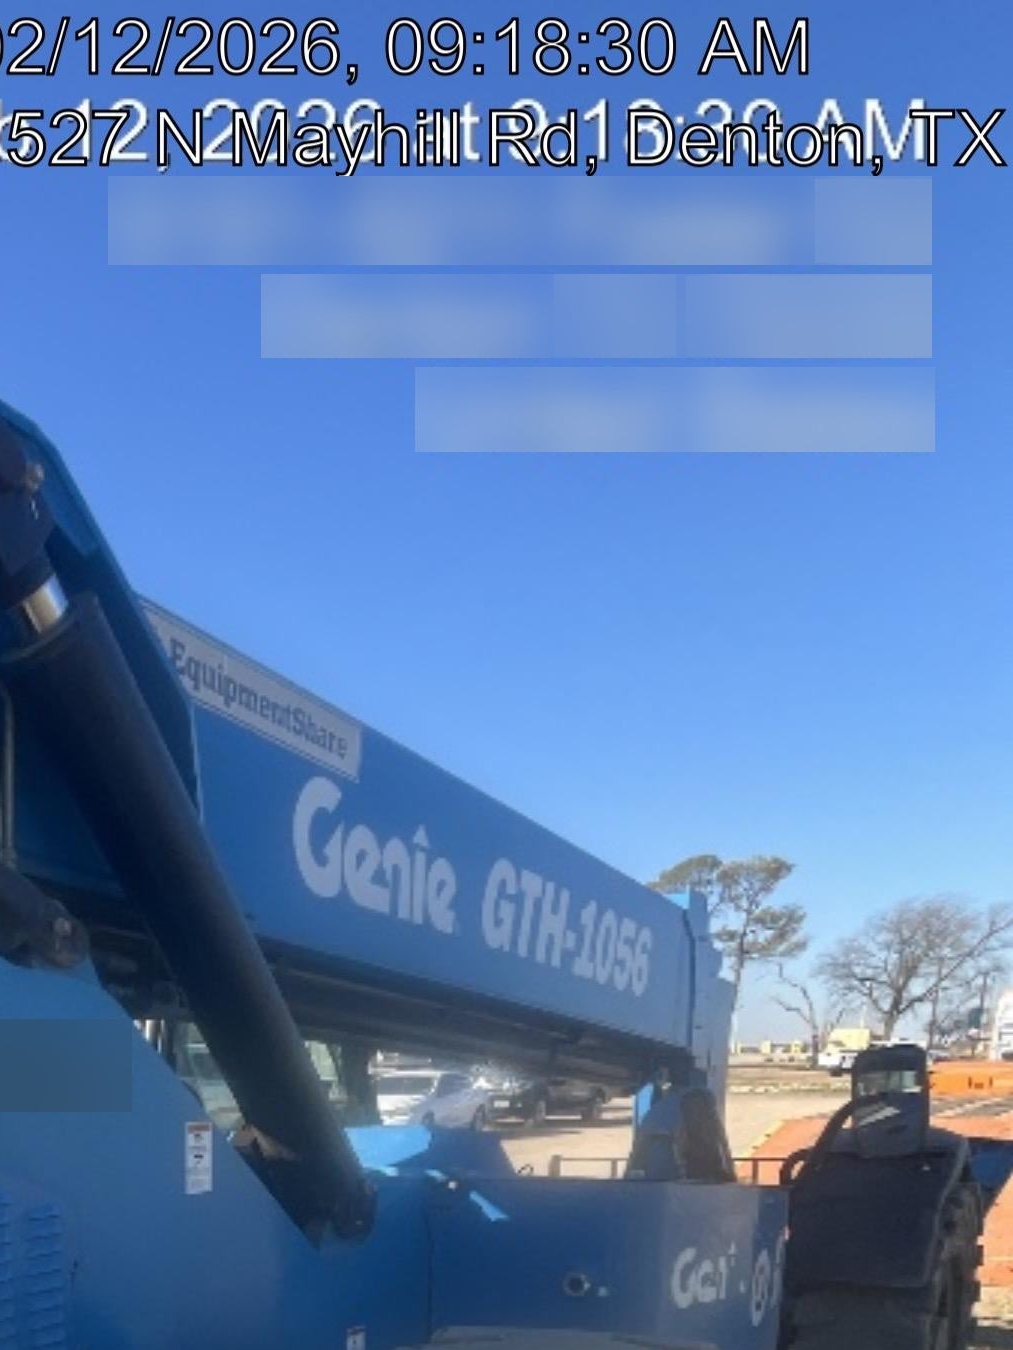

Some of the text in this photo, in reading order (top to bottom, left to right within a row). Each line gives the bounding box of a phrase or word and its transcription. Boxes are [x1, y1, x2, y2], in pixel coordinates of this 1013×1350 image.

[169, 636, 349, 760] EquipmentShare
[292, 776, 653, 997] Genie GTH-1056
